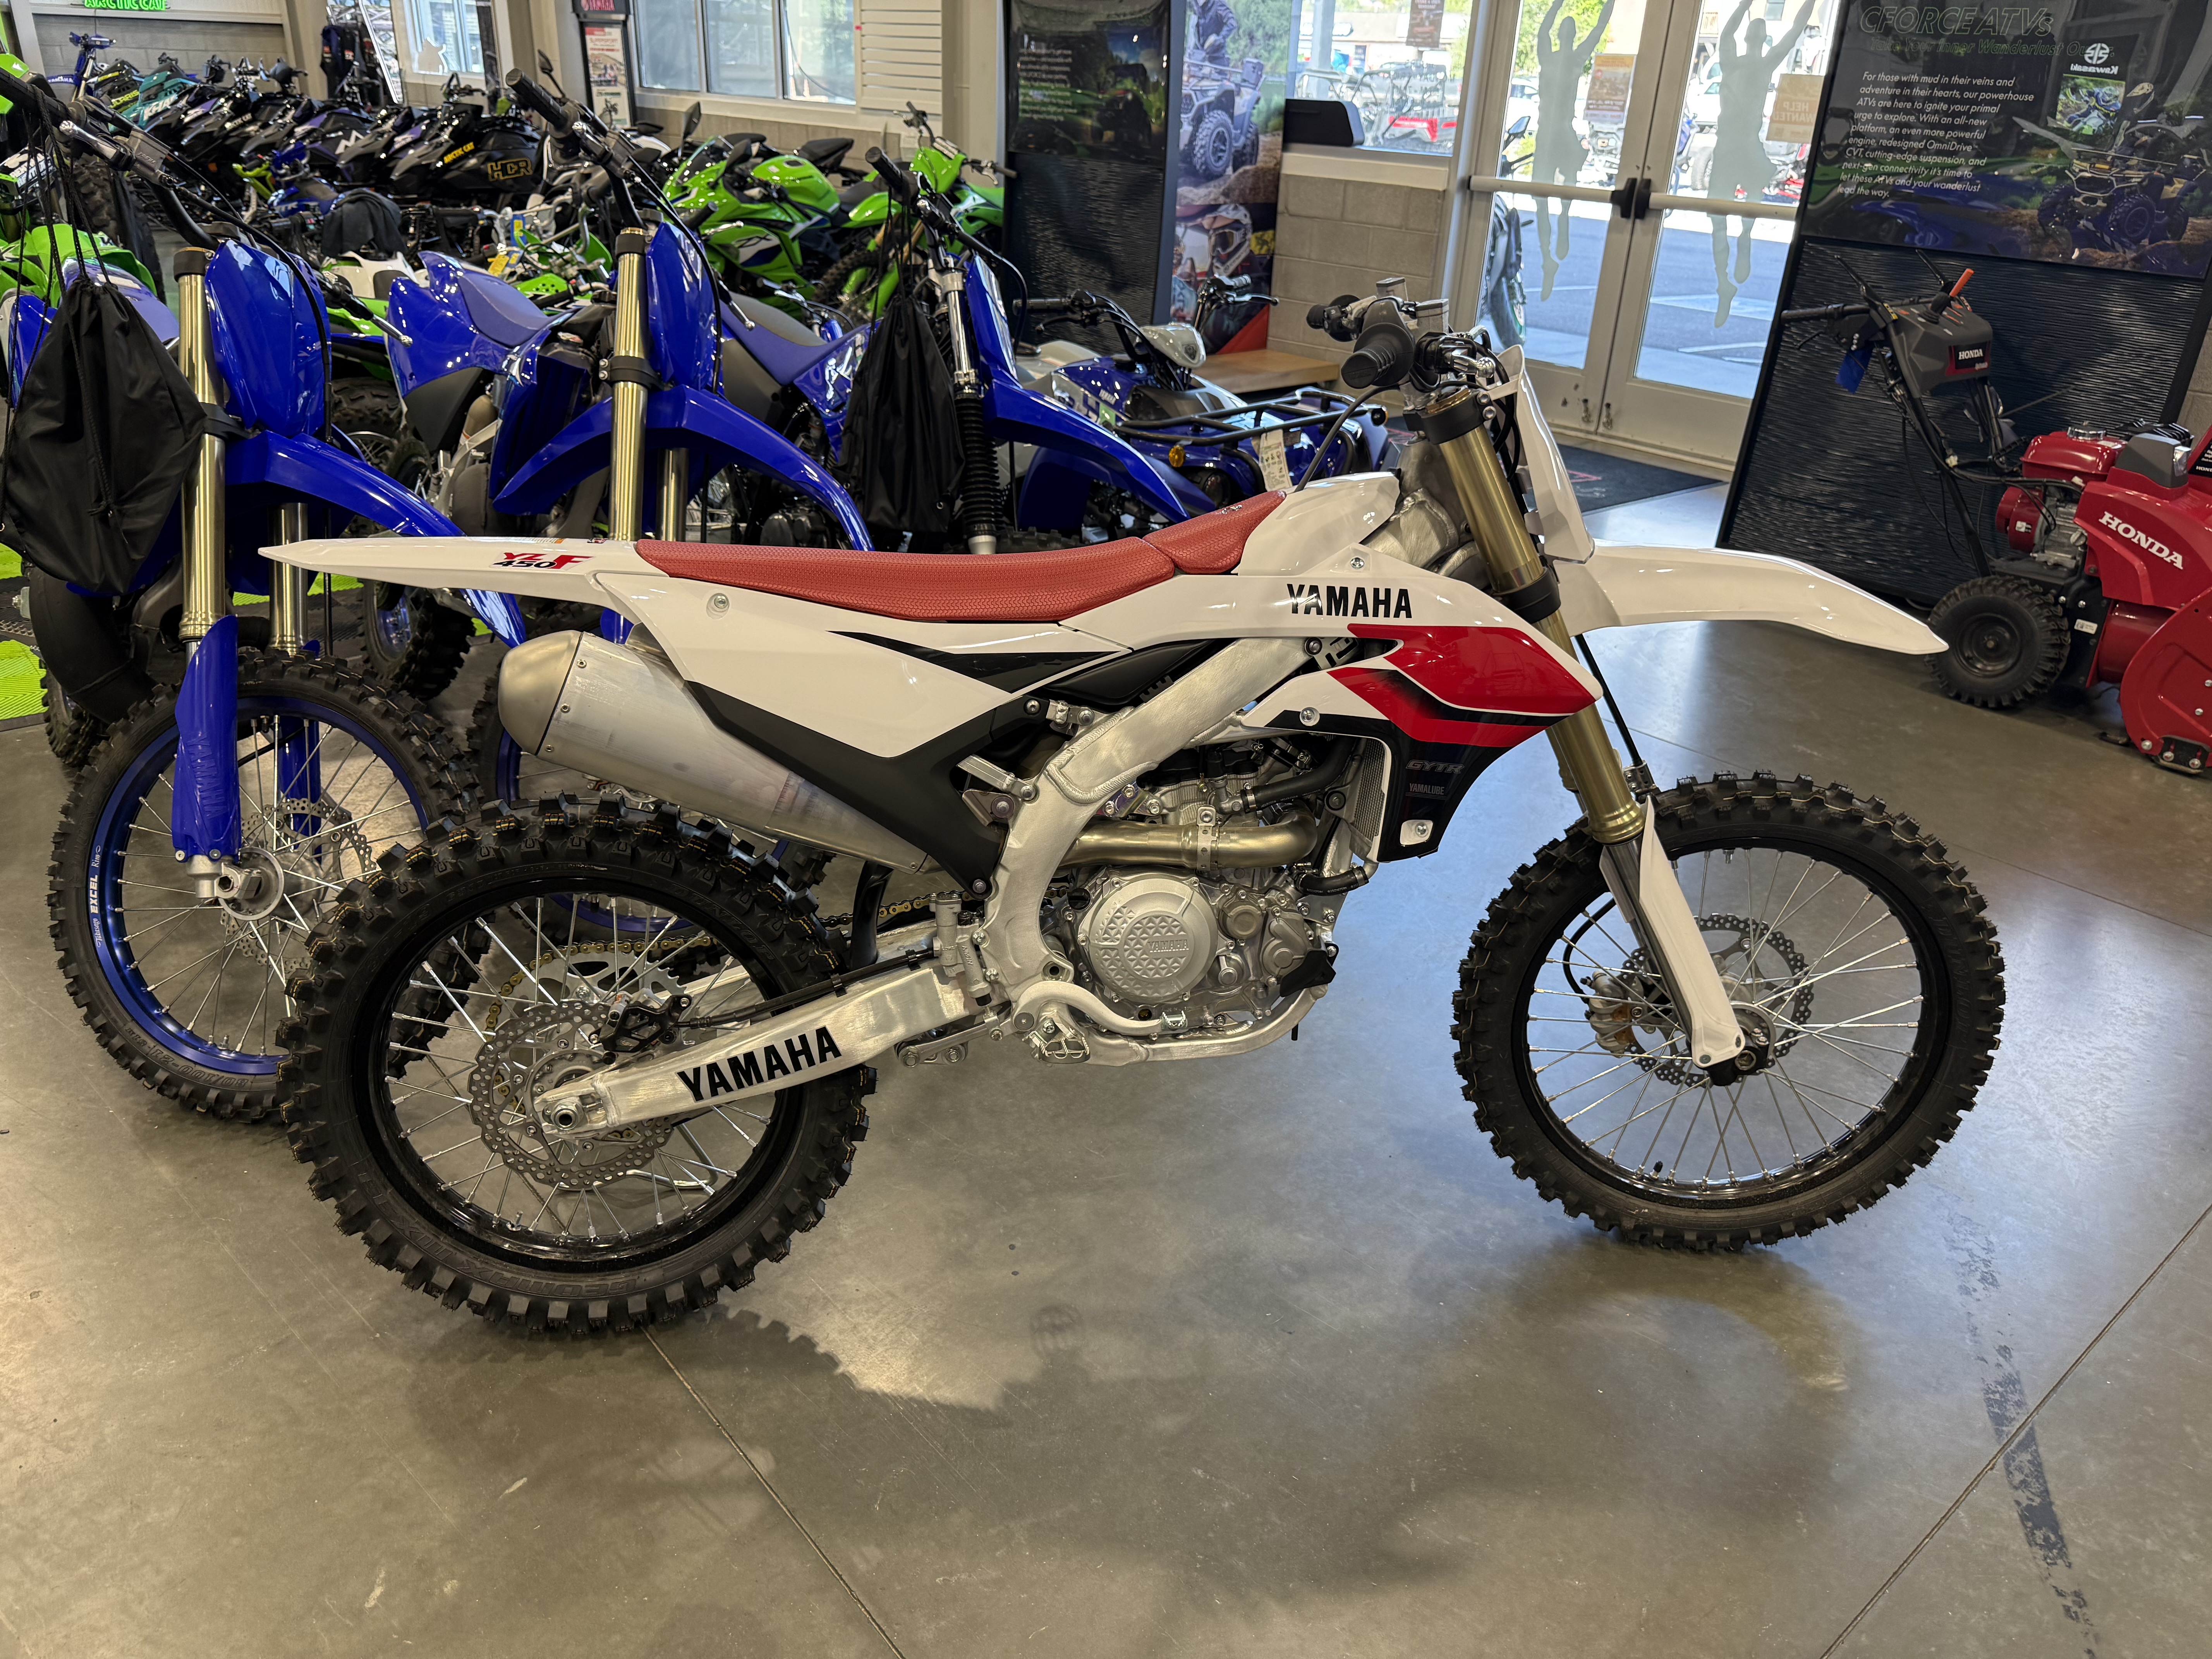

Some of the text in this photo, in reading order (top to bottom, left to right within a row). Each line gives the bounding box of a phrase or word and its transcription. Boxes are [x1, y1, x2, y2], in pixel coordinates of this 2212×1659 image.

[1860, 6, 2054, 36] CFORCE ATVs
[1871, 37, 1901, 51] Take
[1905, 37, 1935, 52] Your
[1937, 38, 1975, 53] Inner
[1978, 39, 2064, 55] Wanderlust
[1863, 71, 2015, 87] For those with mud in their veins and
[1860, 84, 1901, 95] adventure
[1902, 87, 1910, 95] in
[1912, 86, 1932, 96] their
[1933, 88, 1961, 99] hearts,
[1978, 90, 2034, 101] powerhouse
[1856, 97, 1876, 107] ATVs
[1893, 99, 1912, 109] here
[1913, 101, 1922, 109] to
[1924, 101, 1948, 112] ignite
[1949, 104, 1969, 113] your
[1970, 104, 2001, 114] primal
[1854, 112, 1872, 121] urge
[1874, 112, 1882, 120] to
[1884, 112, 1916, 123] explore.
[1920, 113, 1939, 123] With
[1954, 115, 1987, 126] all-new
[1850, 123, 1887, 136] platform,
[1923, 129, 1945, 137] more
[1946, 129, 1986, 139] powerful
[1848, 137, 1876, 147] engine,
[1879, 137, 1926, 150] redesigned
[1846, 147, 1987, 166] CVT, cutting-edge suspension, and
[1842, 161, 1973, 179] next-gen connectivity it's time to
[1840, 172, 1981, 192] let these ATVs and your wanderlust
[1837, 183, 1890, 199] lead the way.
[1958, 349, 1983, 360] HONDA
[2099, 510, 2184, 570] HONDA
[493, 560, 557, 568] 450
[1287, 584, 1413, 619] YAMAHA
[1405, 759, 1465, 774] GYTR
[187, 734, 225, 820] YAMAHA
[1409, 783, 1445, 795] YAMALUBE
[91, 845, 101, 868] Rim
[89, 874, 99, 914] EXCEL
[1147, 939, 1190, 953] YAMAHA
[677, 1026, 842, 1103] YAMAHA
[456, 1258, 638, 1298] GEOMAX
